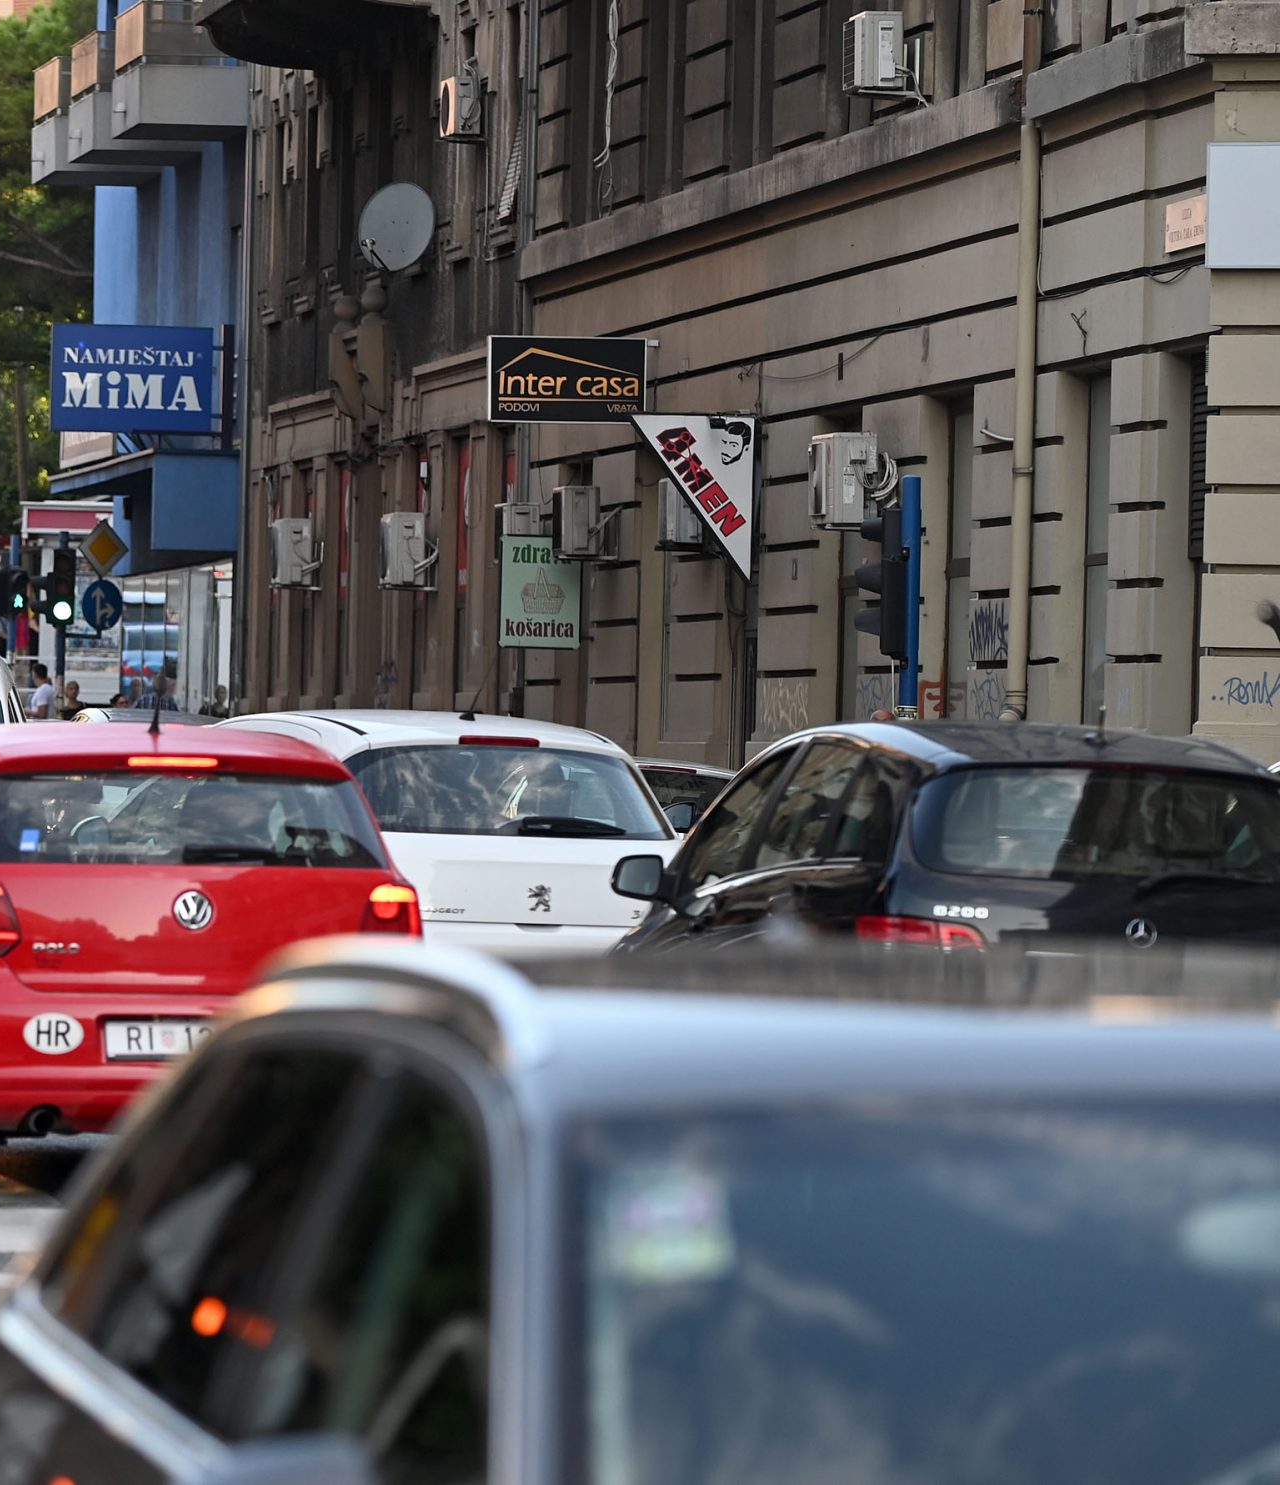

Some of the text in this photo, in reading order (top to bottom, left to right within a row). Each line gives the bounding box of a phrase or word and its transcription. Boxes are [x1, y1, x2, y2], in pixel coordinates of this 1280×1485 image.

[63, 346, 195, 367] NAMJEŠTAJ
[61, 370, 202, 412] MiMA
[499, 370, 639, 397] Inter casa
[498, 402, 540, 412] PODOVI
[607, 403, 639, 413] VRATA
[512, 544, 572, 565] zdra
[505, 618, 574, 638] košarica
[32, 942, 80, 954] POLO
[35, 1019, 71, 1047] HR
[127, 1026, 154, 1052] RI
